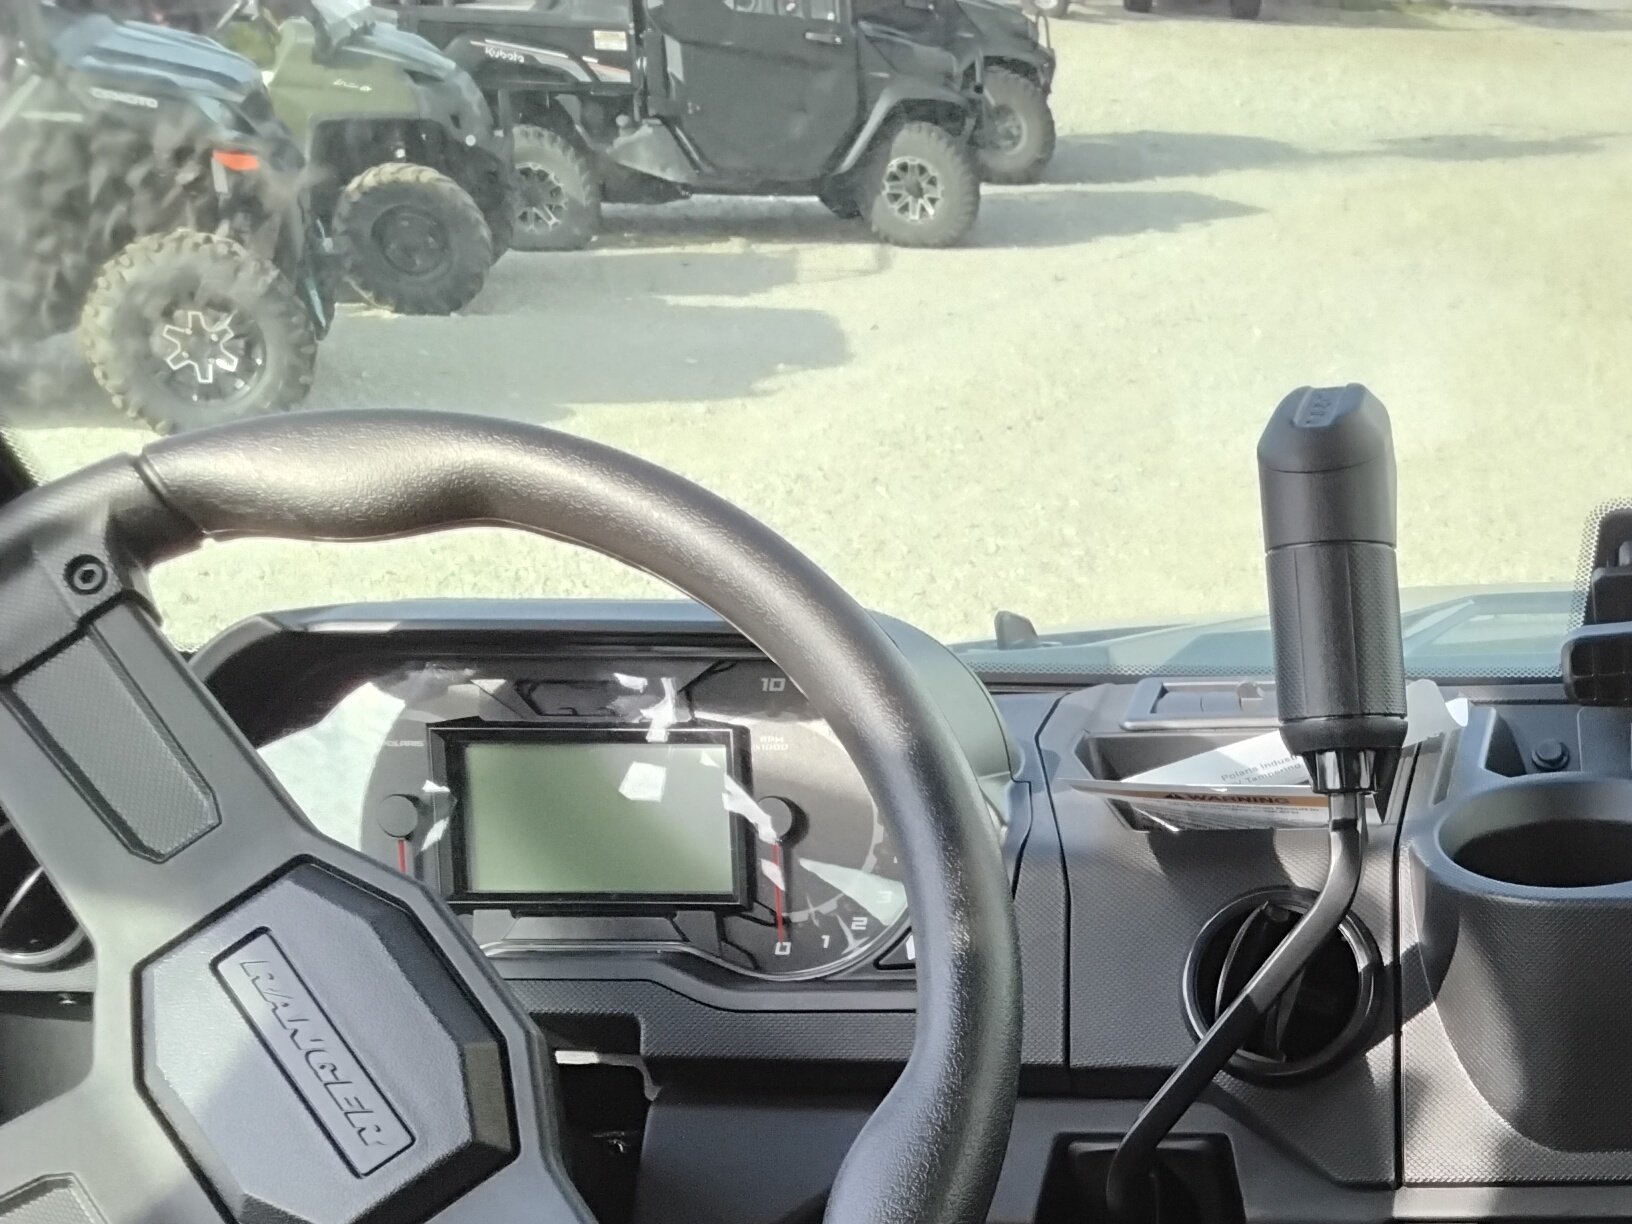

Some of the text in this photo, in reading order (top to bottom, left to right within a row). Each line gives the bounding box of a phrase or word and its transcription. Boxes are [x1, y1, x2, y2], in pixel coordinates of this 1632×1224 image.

[485, 47, 525, 63] Kubota
[761, 678, 786, 692] 10
[1221, 767, 1259, 782] Polaris
[1244, 763, 1301, 783] Tampering
[1186, 792, 1290, 804] WARNING
[877, 890, 894, 903] 3
[851, 917, 868, 930] 2
[774, 942, 792, 956] 0
[821, 935, 830, 949] 1
[239, 960, 388, 1147] RANGER
